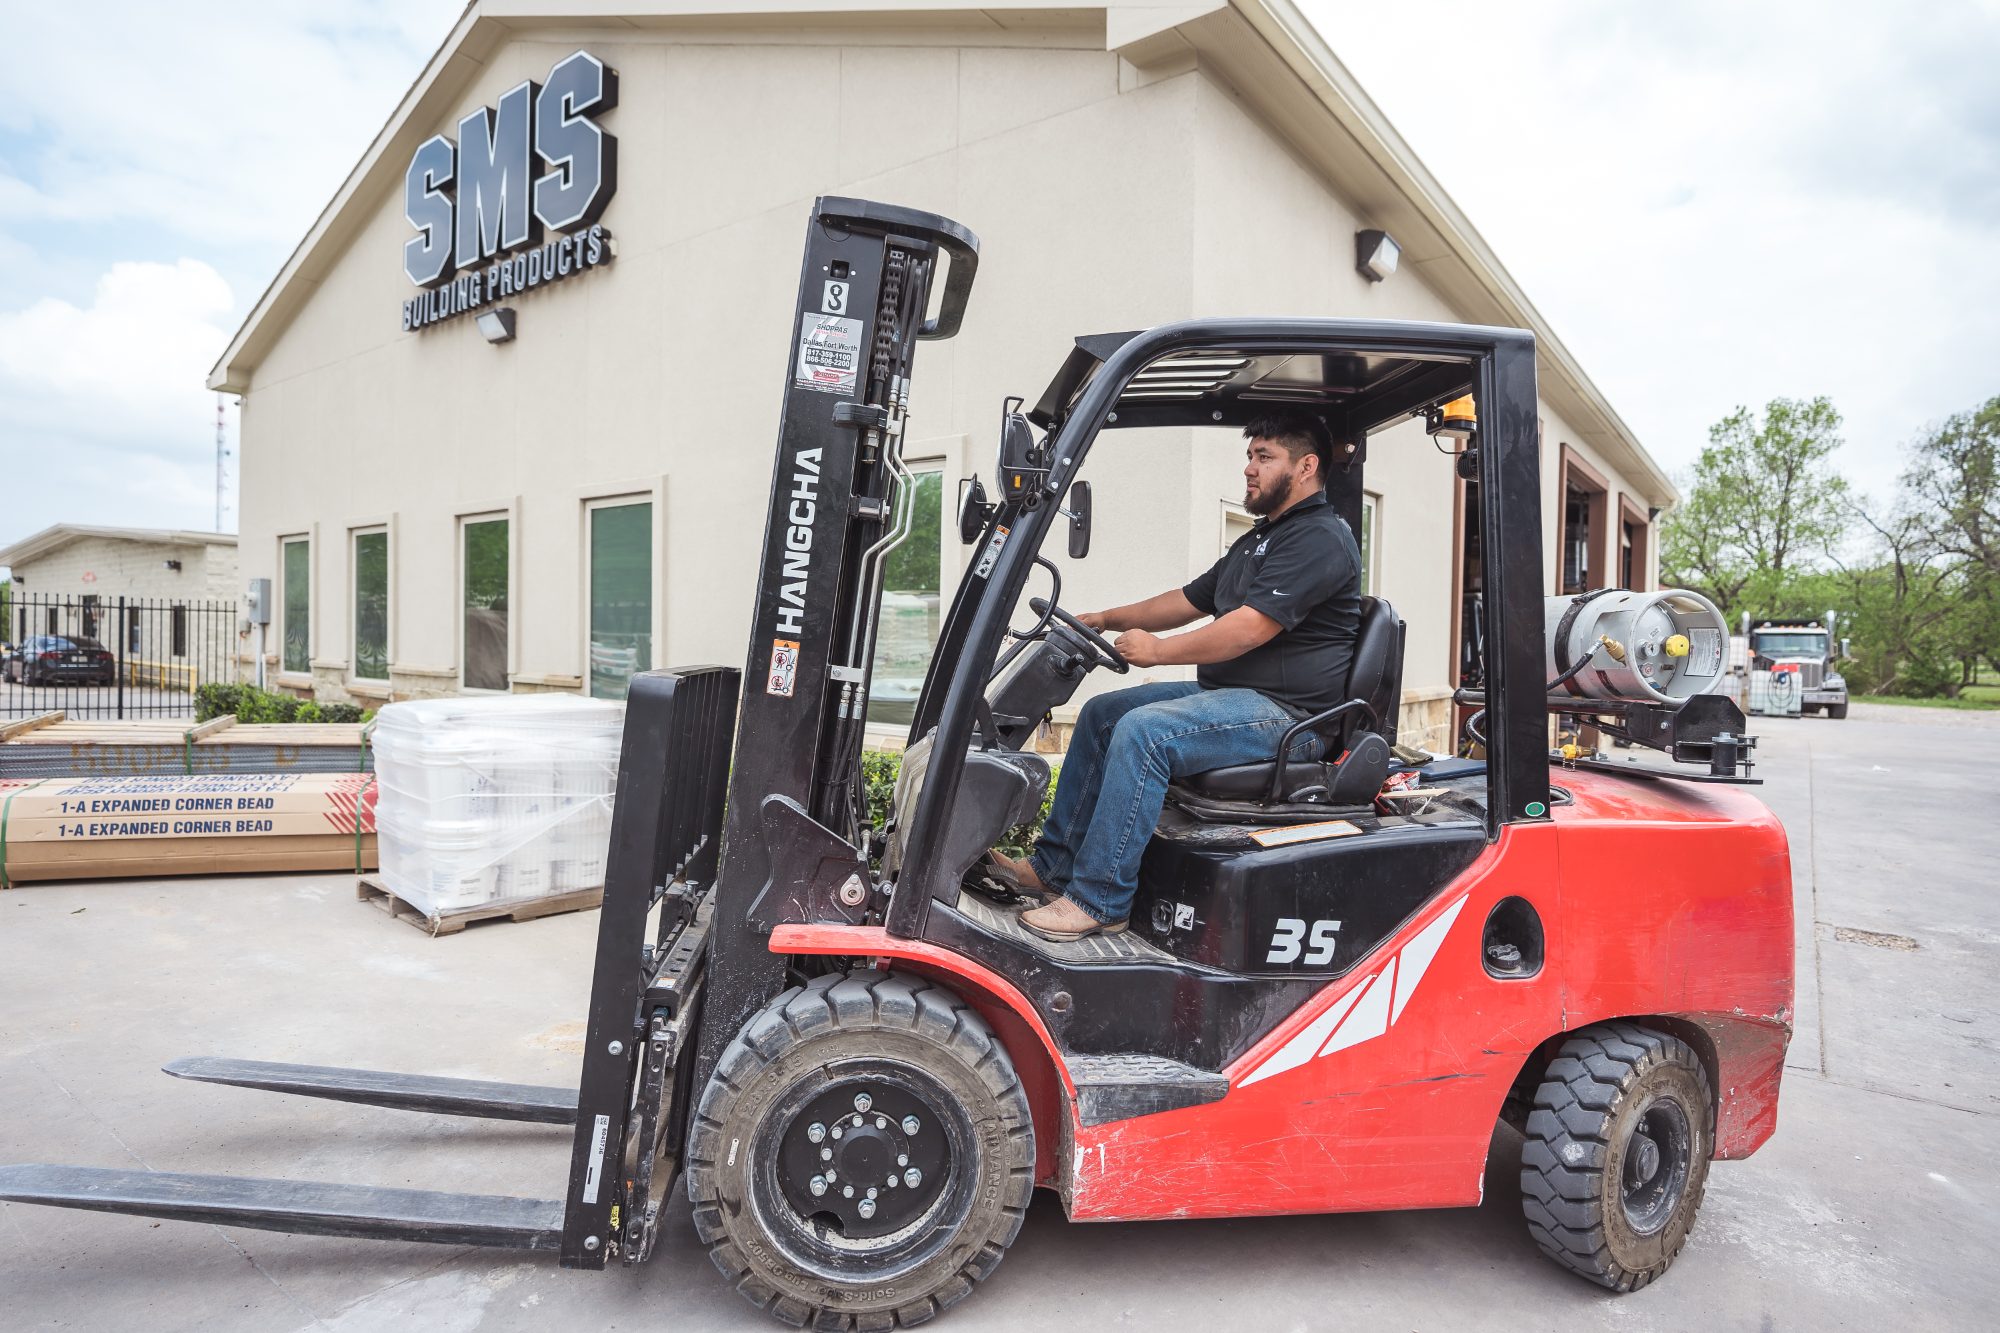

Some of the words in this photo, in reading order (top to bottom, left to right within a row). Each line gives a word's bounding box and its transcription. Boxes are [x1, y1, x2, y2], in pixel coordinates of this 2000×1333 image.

[404, 50, 614, 287] SMS
[402, 270, 481, 332] BUILDING
[486, 223, 604, 301] PRODUCTS
[839, 341, 857, 352] Worth
[776, 447, 823, 634] HANGCHA
[58, 823, 84, 836] 1-A
[89, 821, 169, 835] EXPANDED
[173, 820, 231, 833] CORNER
[236, 819, 273, 832] BEAD
[61, 800, 86, 813] 1-A
[91, 799, 170, 813] EXPANDED
[175, 798, 233, 811] CORNER
[237, 797, 274, 810] BEAD
[1266, 918, 1342, 965] 35
[984, 1123, 1001, 1209] ADVANCE
